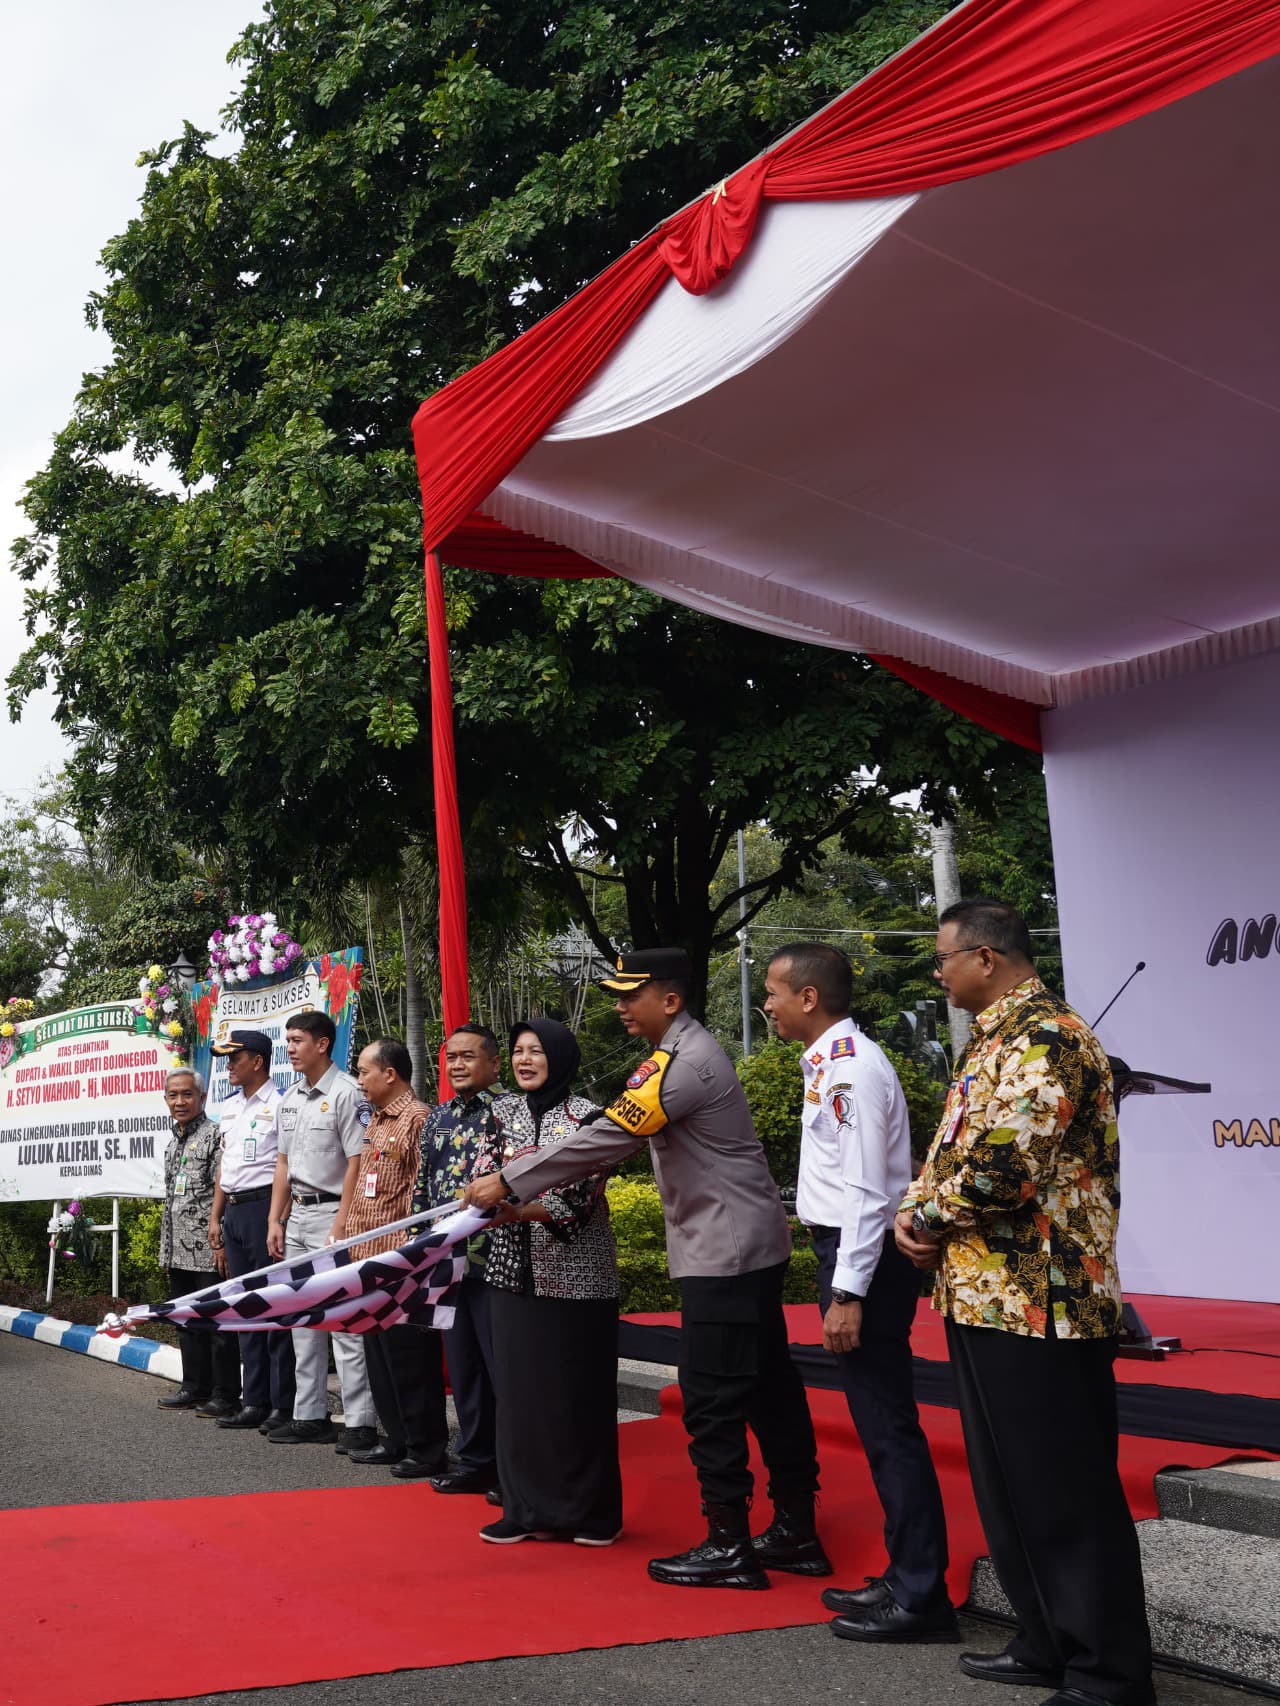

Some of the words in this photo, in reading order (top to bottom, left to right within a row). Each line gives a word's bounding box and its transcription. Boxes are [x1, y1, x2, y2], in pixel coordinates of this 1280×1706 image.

[222, 999, 261, 1015] SELAMAT
[263, 998, 268, 1012] &
[271, 982, 311, 1010] SUKSES
[36, 1018, 75, 1042] SELAMAT
[77, 1015, 94, 1029] DAN
[96, 1011, 134, 1026] SUKSES
[57, 1044, 72, 1058] ATAS
[72, 1040, 109, 1056] PELANTIKAN
[16, 1067, 41, 1083] BUPATI
[41, 1068, 47, 1078] &
[48, 1061, 72, 1078] WAKIL
[74, 1057, 102, 1074] BUPATI
[103, 1049, 158, 1071] BOJONEGORO
[7, 1089, 16, 1108] H.
[16, 1084, 41, 1107] SETYO
[43, 1079, 80, 1104] WAHONO
[87, 1078, 99, 1101] Hj.
[101, 1073, 132, 1097] NURUL
[0, 1129, 22, 1143] DINAS
[22, 1124, 70, 1142] LINGKUNGAN
[71, 1122, 96, 1137] HIDUP
[97, 1119, 117, 1134] KAB.
[118, 1115, 174, 1133] BOJONEGORO
[18, 1143, 54, 1165] LULUK
[56, 1139, 102, 1163] ALIFAH,
[104, 1137, 127, 1162] SE.,
[129, 1136, 155, 1159] MM
[59, 1165, 82, 1177] KEPALA
[83, 1164, 103, 1176] DINAS
